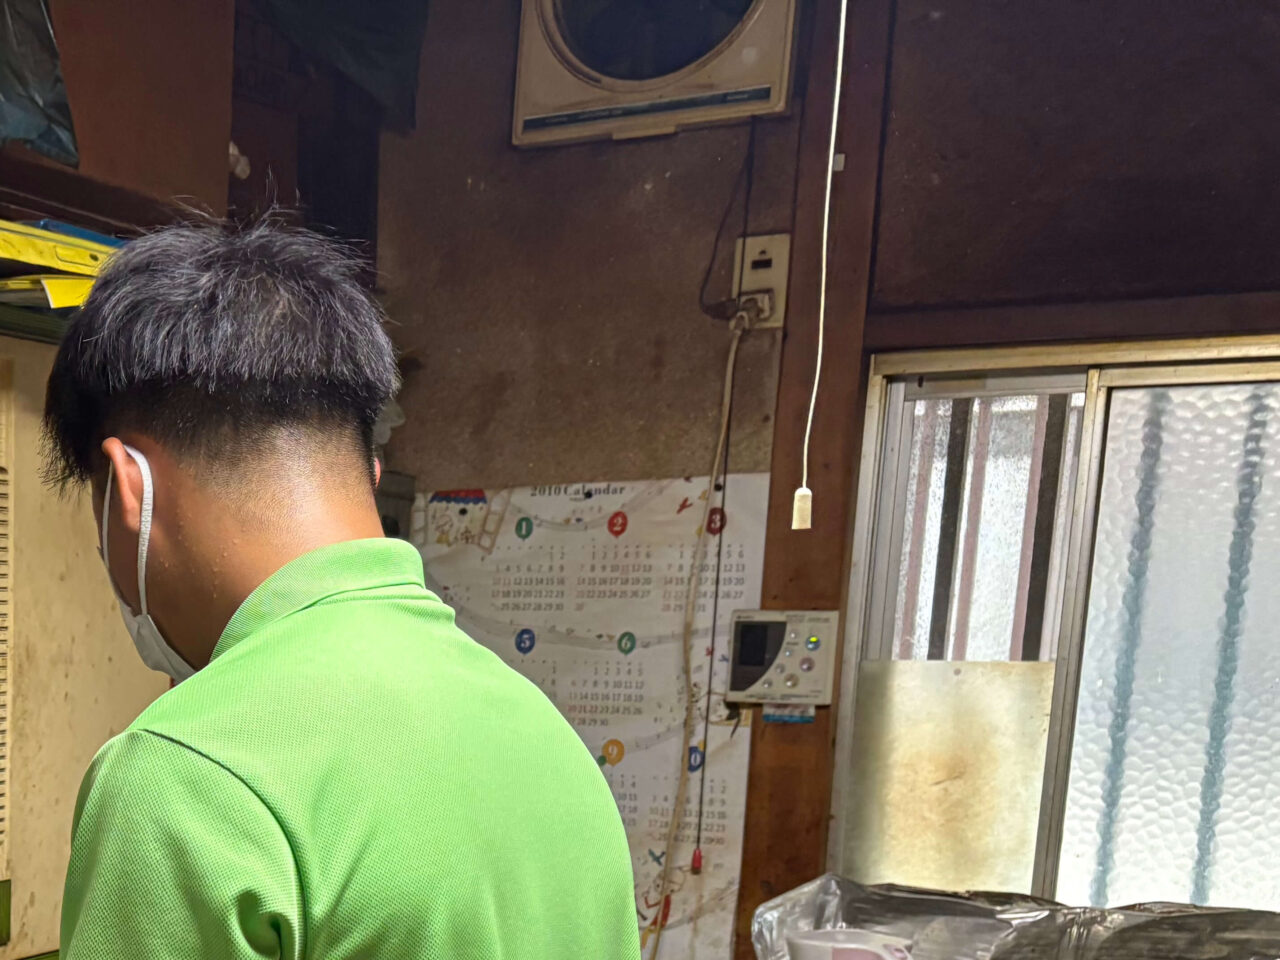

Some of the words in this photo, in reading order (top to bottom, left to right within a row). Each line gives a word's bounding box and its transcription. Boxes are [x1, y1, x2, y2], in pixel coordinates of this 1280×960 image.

[531, 485, 561, 497] 2010
[613, 517, 622, 531] 2
[711, 513, 720, 528] 3
[521, 634, 530, 648] 5
[621, 636, 631, 650] 6
[608, 745, 618, 758] 9
